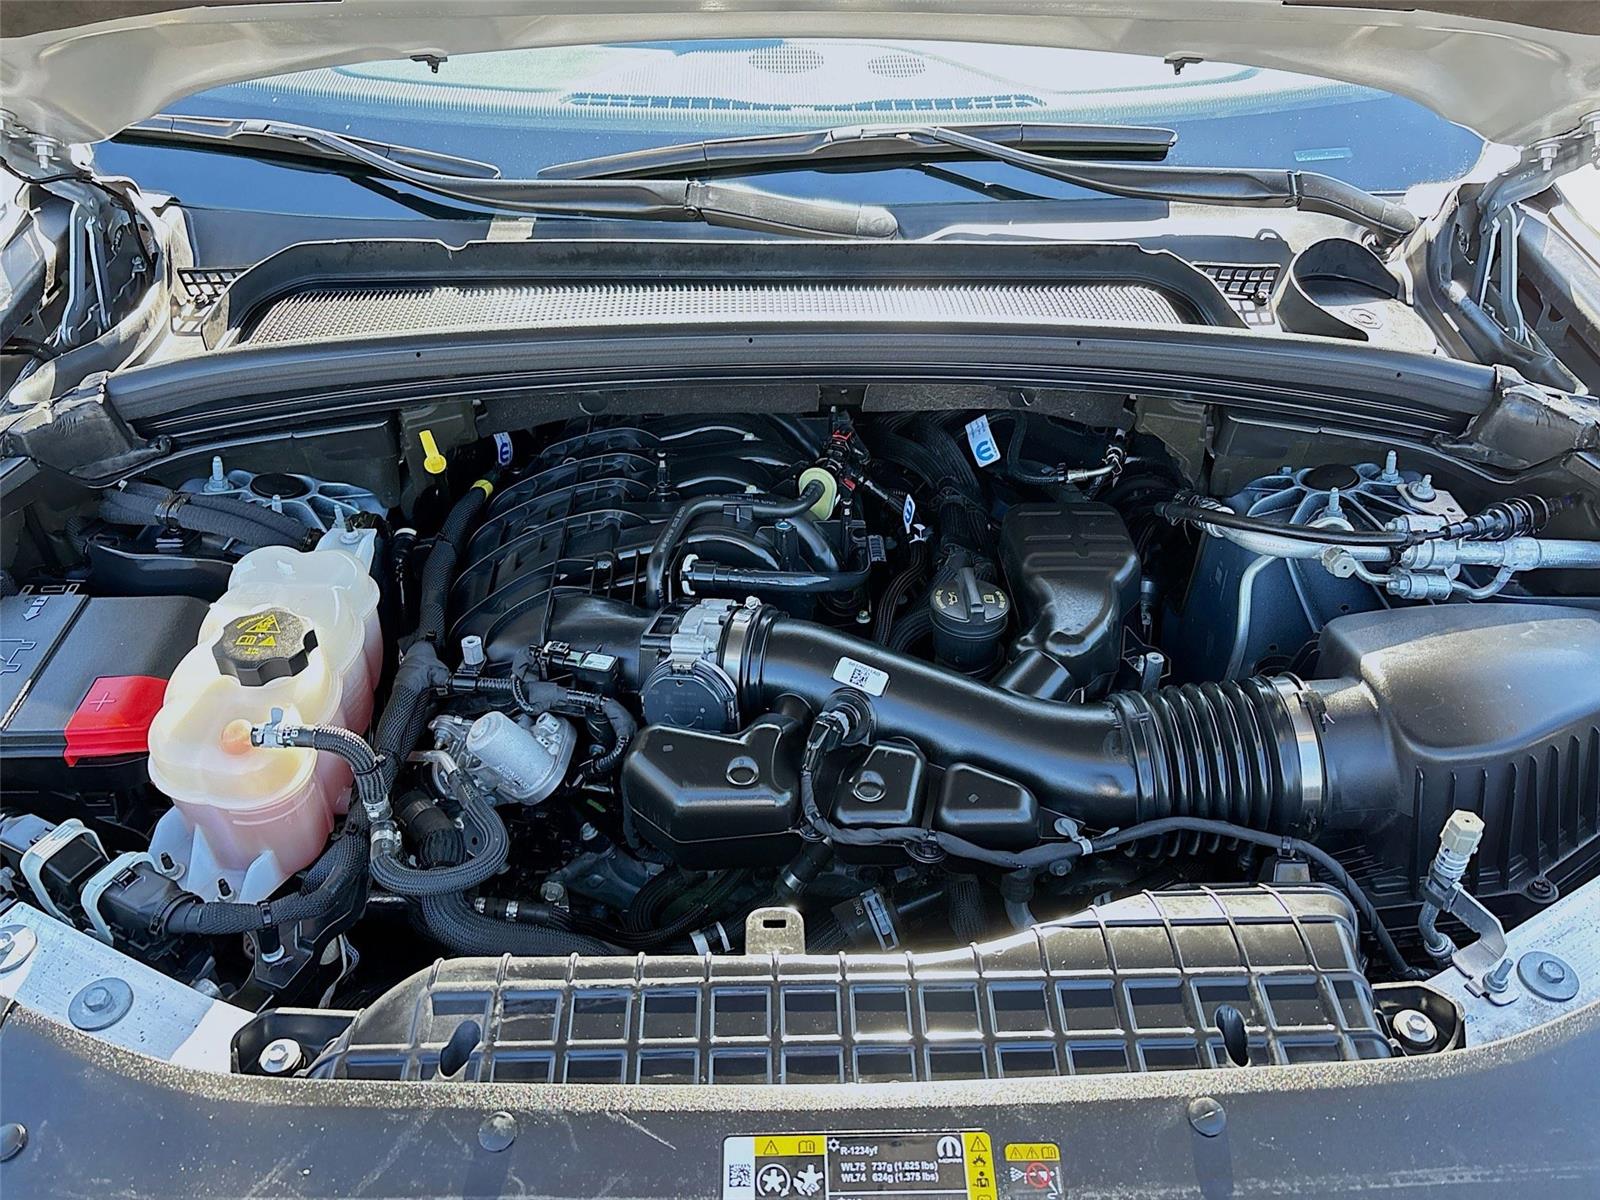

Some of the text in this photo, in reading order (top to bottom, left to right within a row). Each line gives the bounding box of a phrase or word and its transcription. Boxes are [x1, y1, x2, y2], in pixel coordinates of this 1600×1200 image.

[840, 1145, 878, 1157] R-1234yf
[841, 1162, 866, 1172] WL75
[872, 1162, 893, 1173] 737g
[921, 1160, 938, 1172] lbs)
[841, 1171, 939, 1183] WL74 624g (1.375 lbs)
